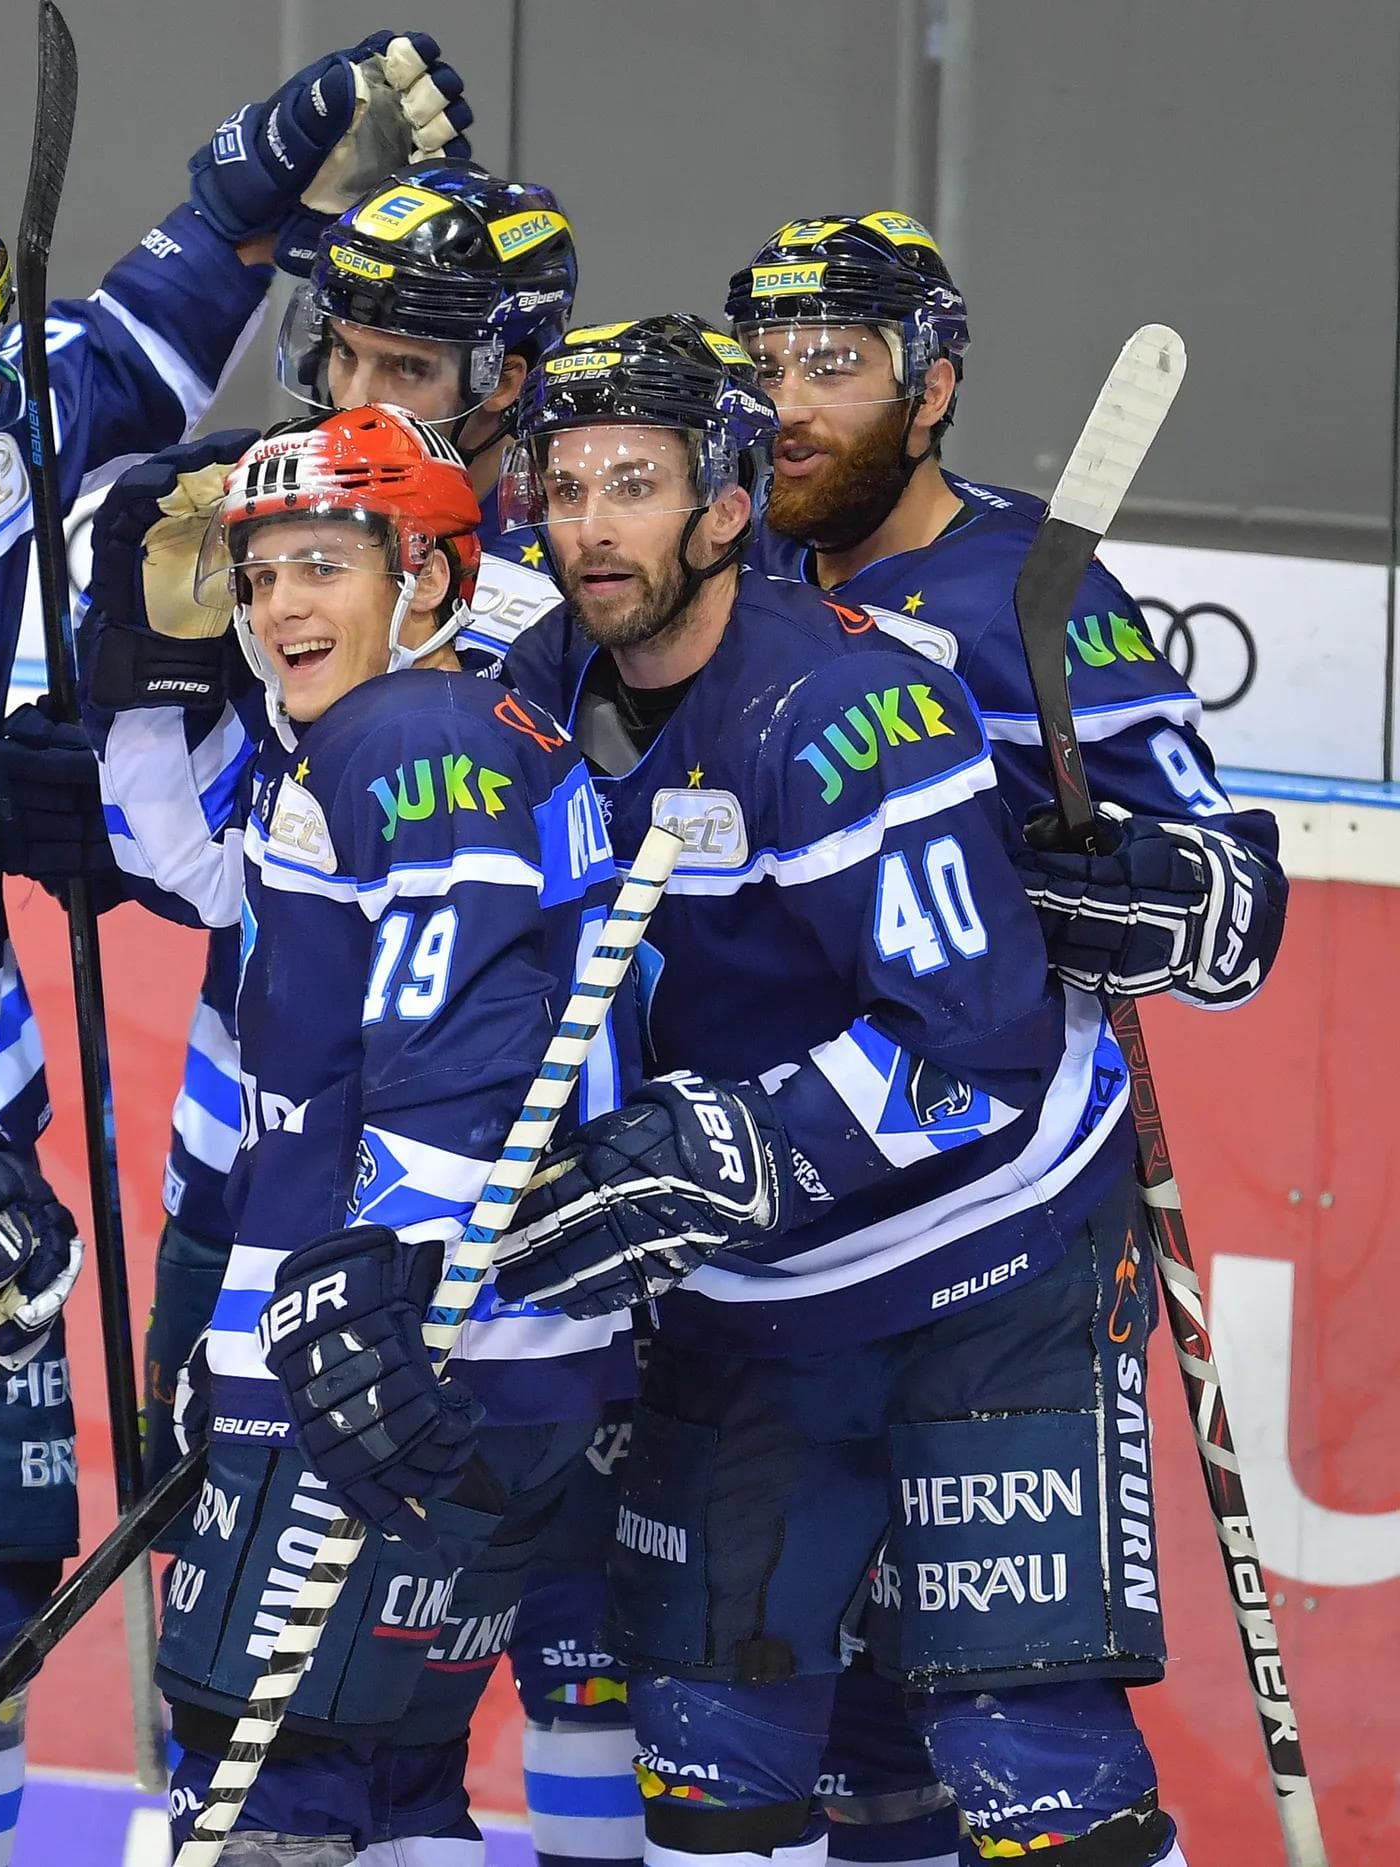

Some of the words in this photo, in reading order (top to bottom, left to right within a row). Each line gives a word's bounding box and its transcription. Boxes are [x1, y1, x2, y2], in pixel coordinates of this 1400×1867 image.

[499, 213, 552, 249] EDEKA
[335, 250, 381, 277] EDEKA
[755, 270, 819, 289] EDEKA
[553, 353, 609, 371] EDEKA
[794, 684, 956, 805] JUKE
[366, 754, 513, 842] JUKE
[874, 834, 989, 978] 40
[361, 904, 459, 1028] 19
[931, 1252, 1030, 1310] BAUER
[212, 1415, 291, 1440] BAUER
[901, 1468, 1083, 1527] HERRN
[1115, 1352, 1161, 1614] SATURN
[616, 1504, 687, 1564] SATURN
[917, 1553, 1067, 1612] BRÄU
